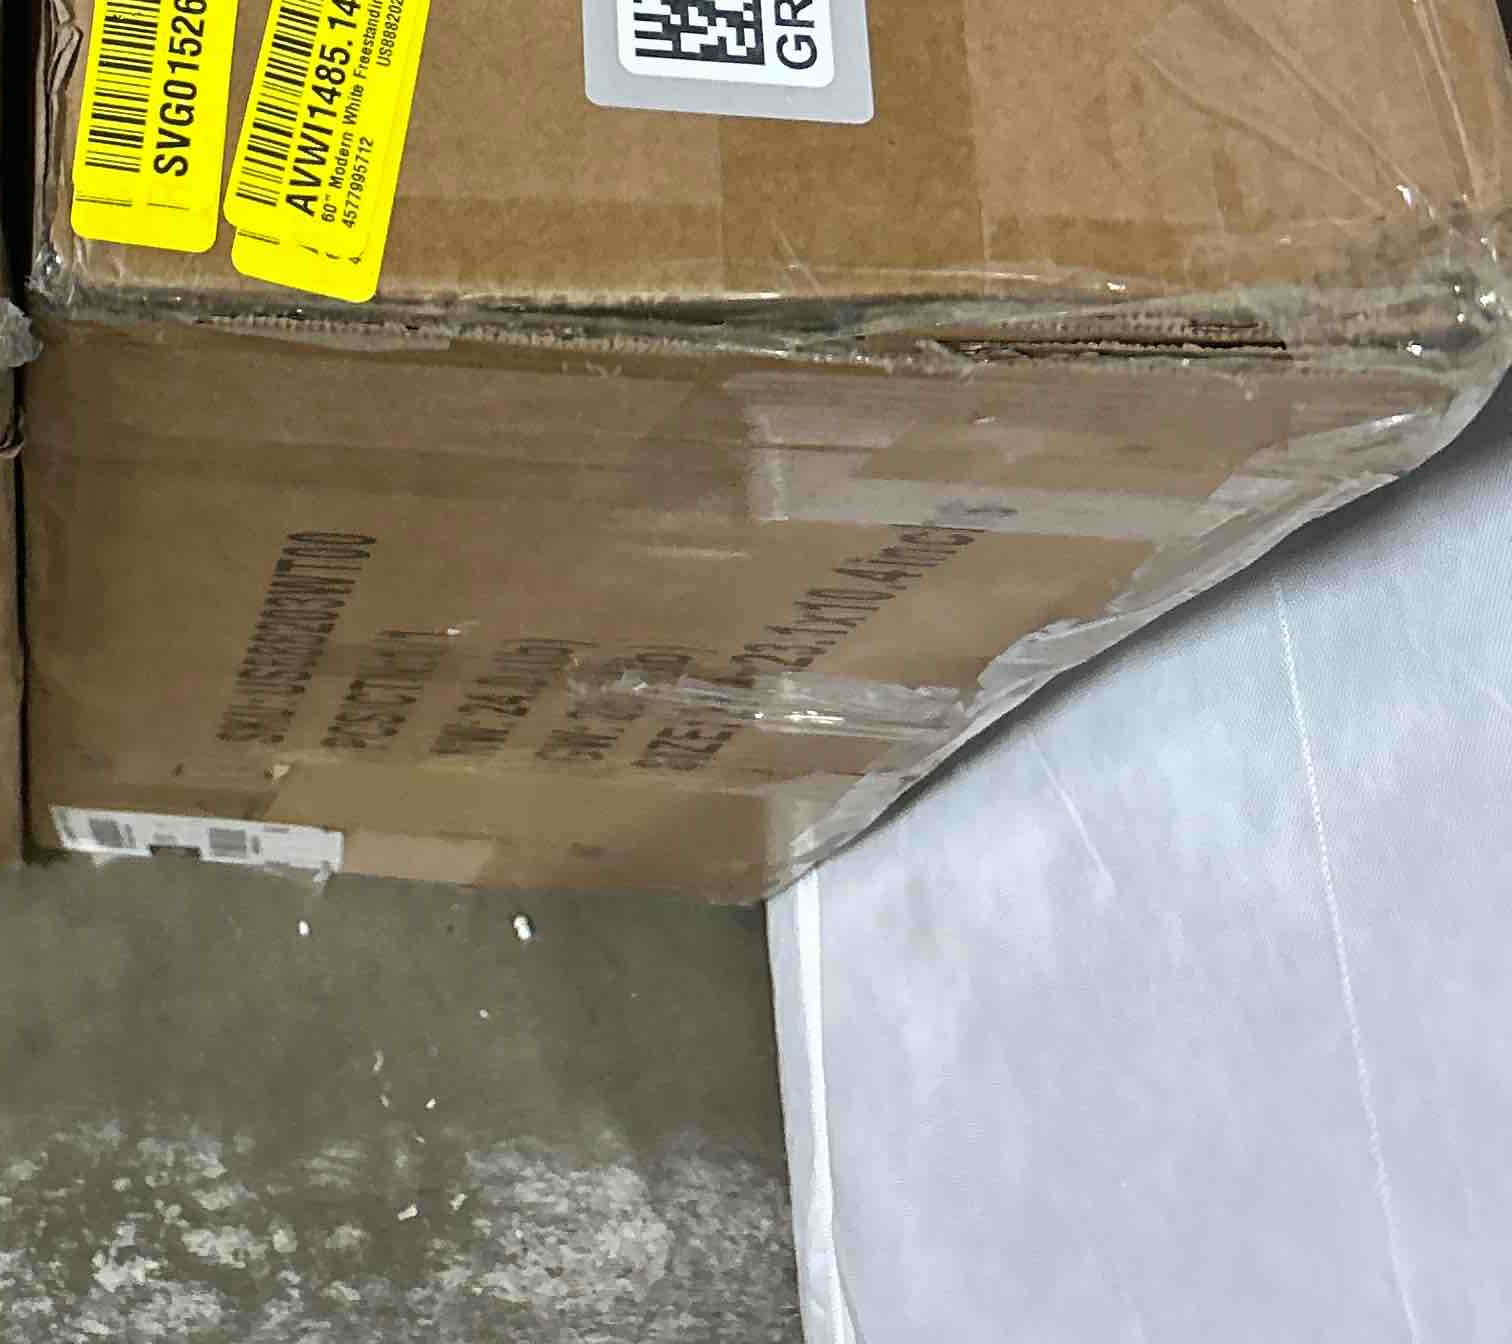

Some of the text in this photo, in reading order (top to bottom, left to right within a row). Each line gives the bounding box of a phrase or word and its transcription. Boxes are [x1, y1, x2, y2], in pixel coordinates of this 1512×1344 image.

[328, 131, 354, 190] Modern
[342, 83, 365, 126] White
[340, 135, 375, 229] 4577995712
